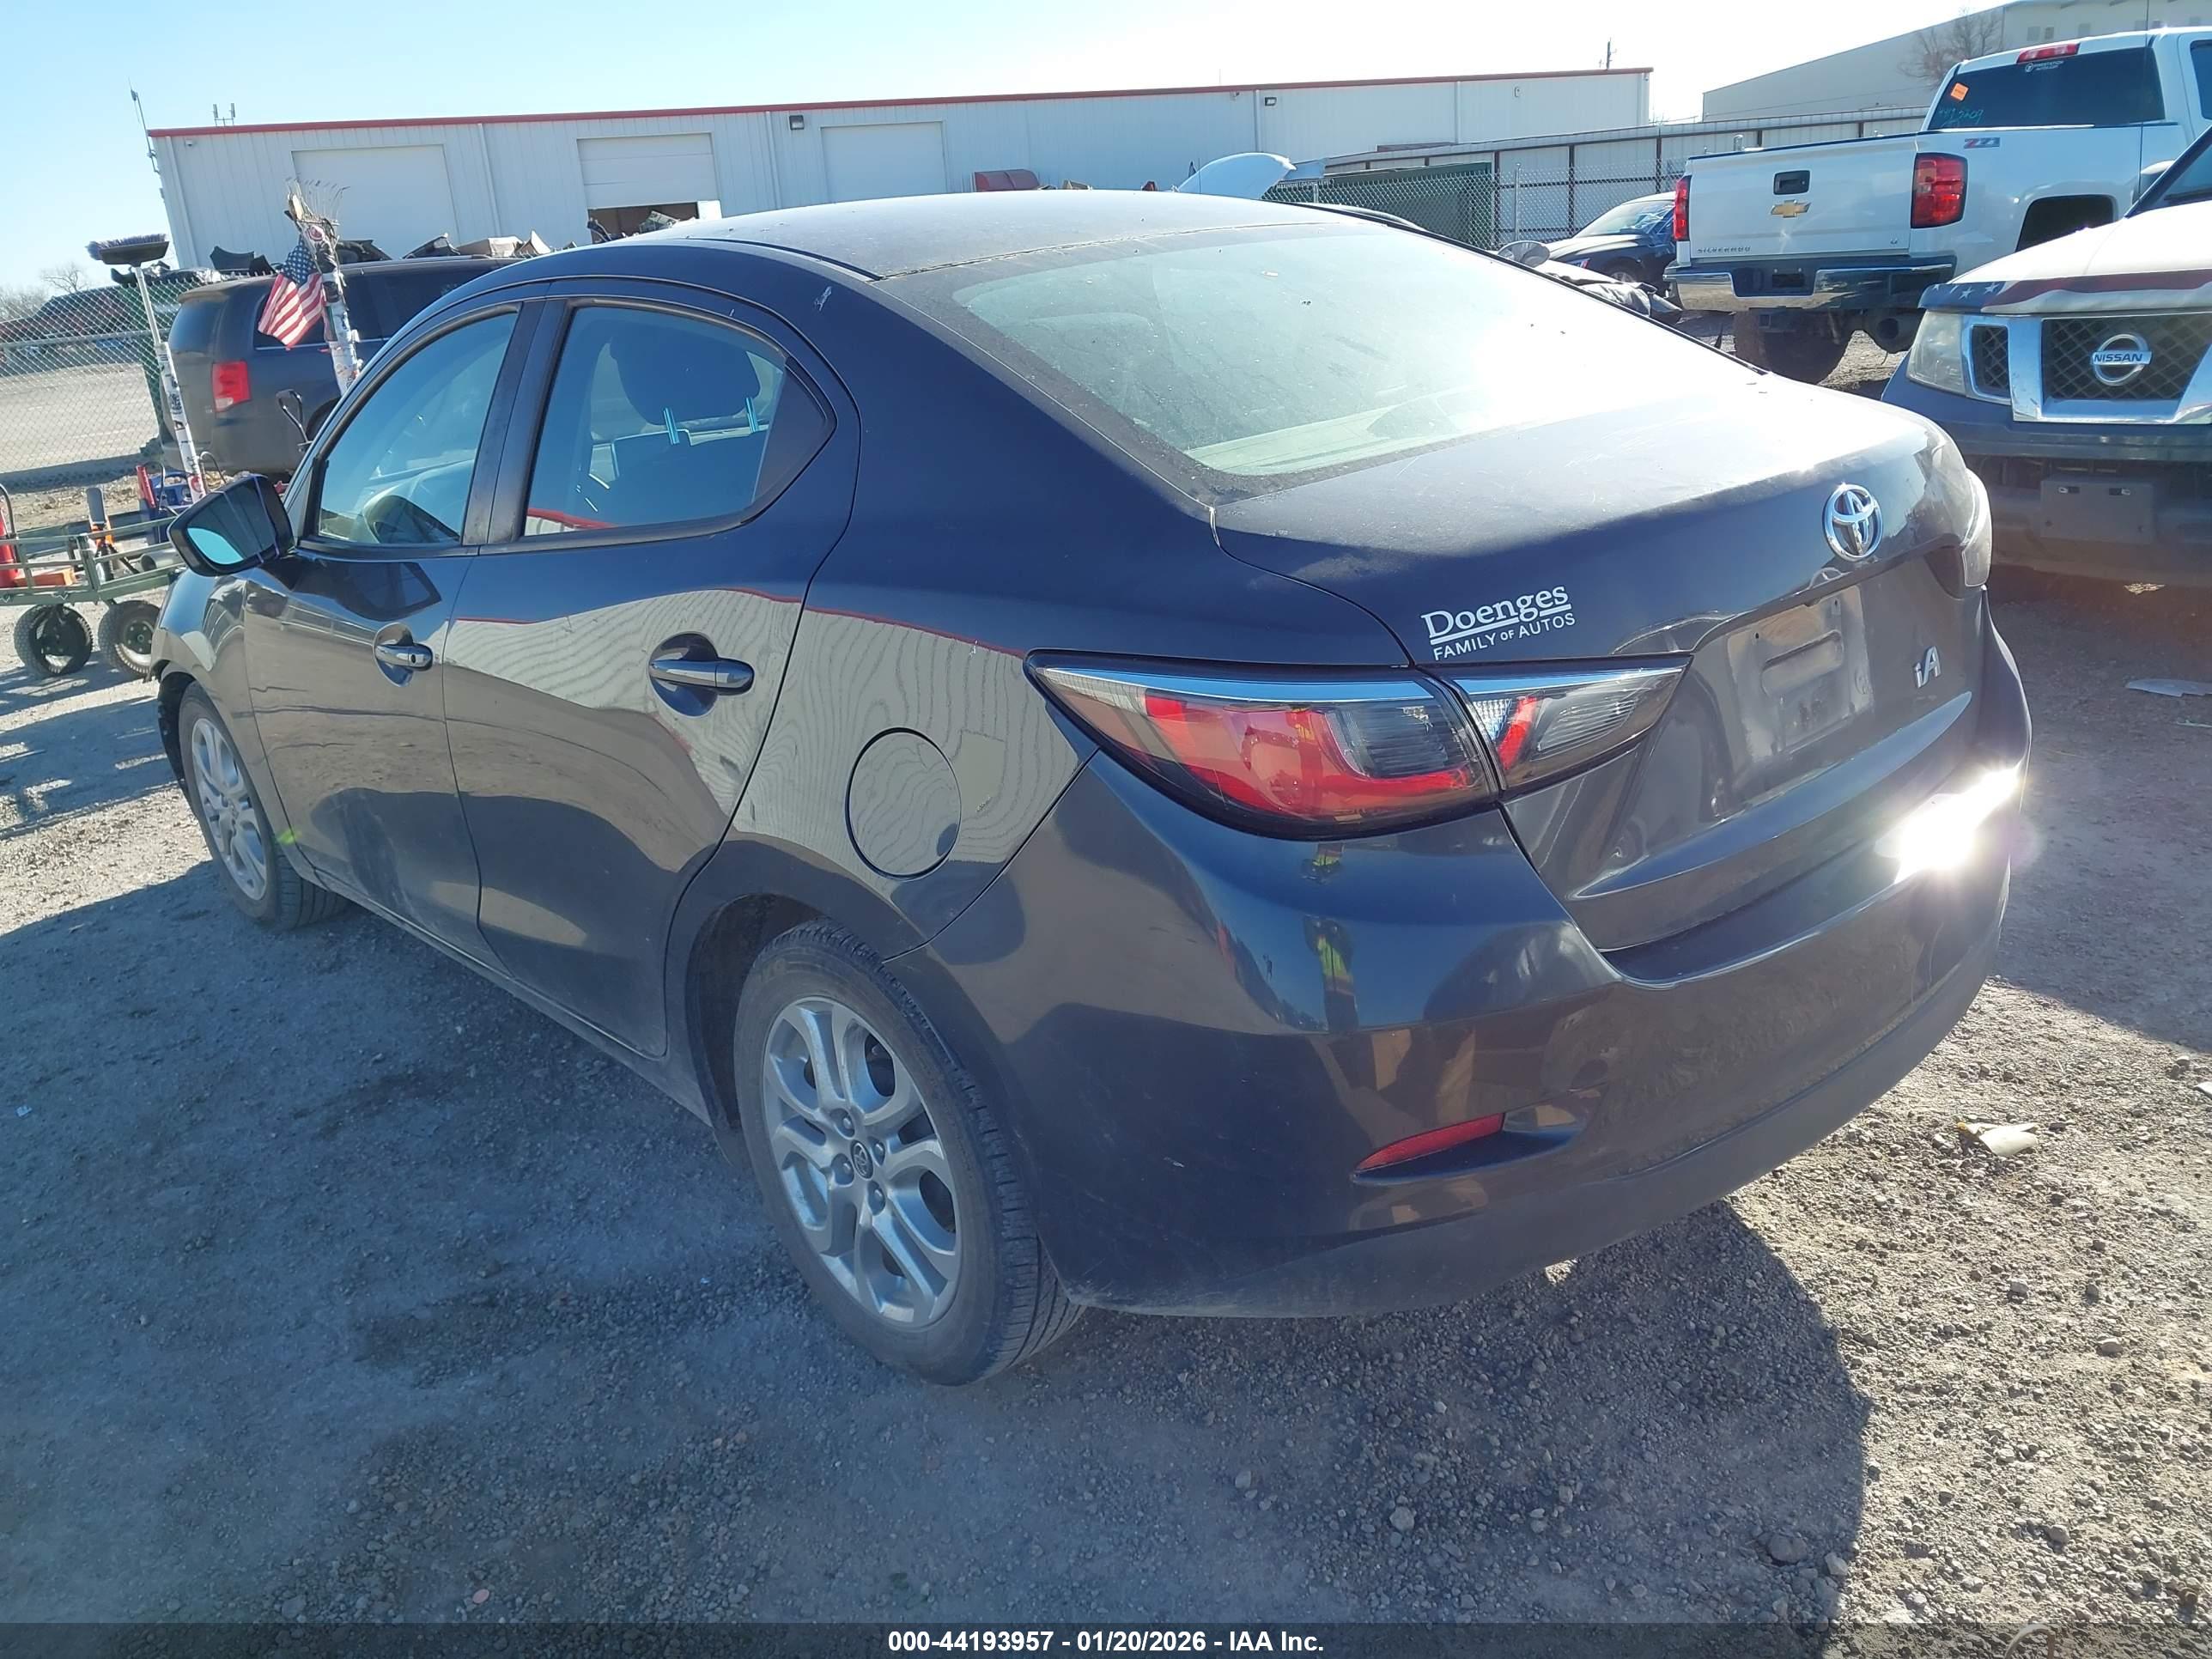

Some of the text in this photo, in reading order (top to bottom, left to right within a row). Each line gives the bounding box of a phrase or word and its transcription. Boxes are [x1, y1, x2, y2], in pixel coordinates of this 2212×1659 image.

[2094, 353, 2143, 362] NISSAN
[1420, 586, 1569, 639] Doenges
[1433, 612, 1576, 661] FAMILY OF AUTOS
